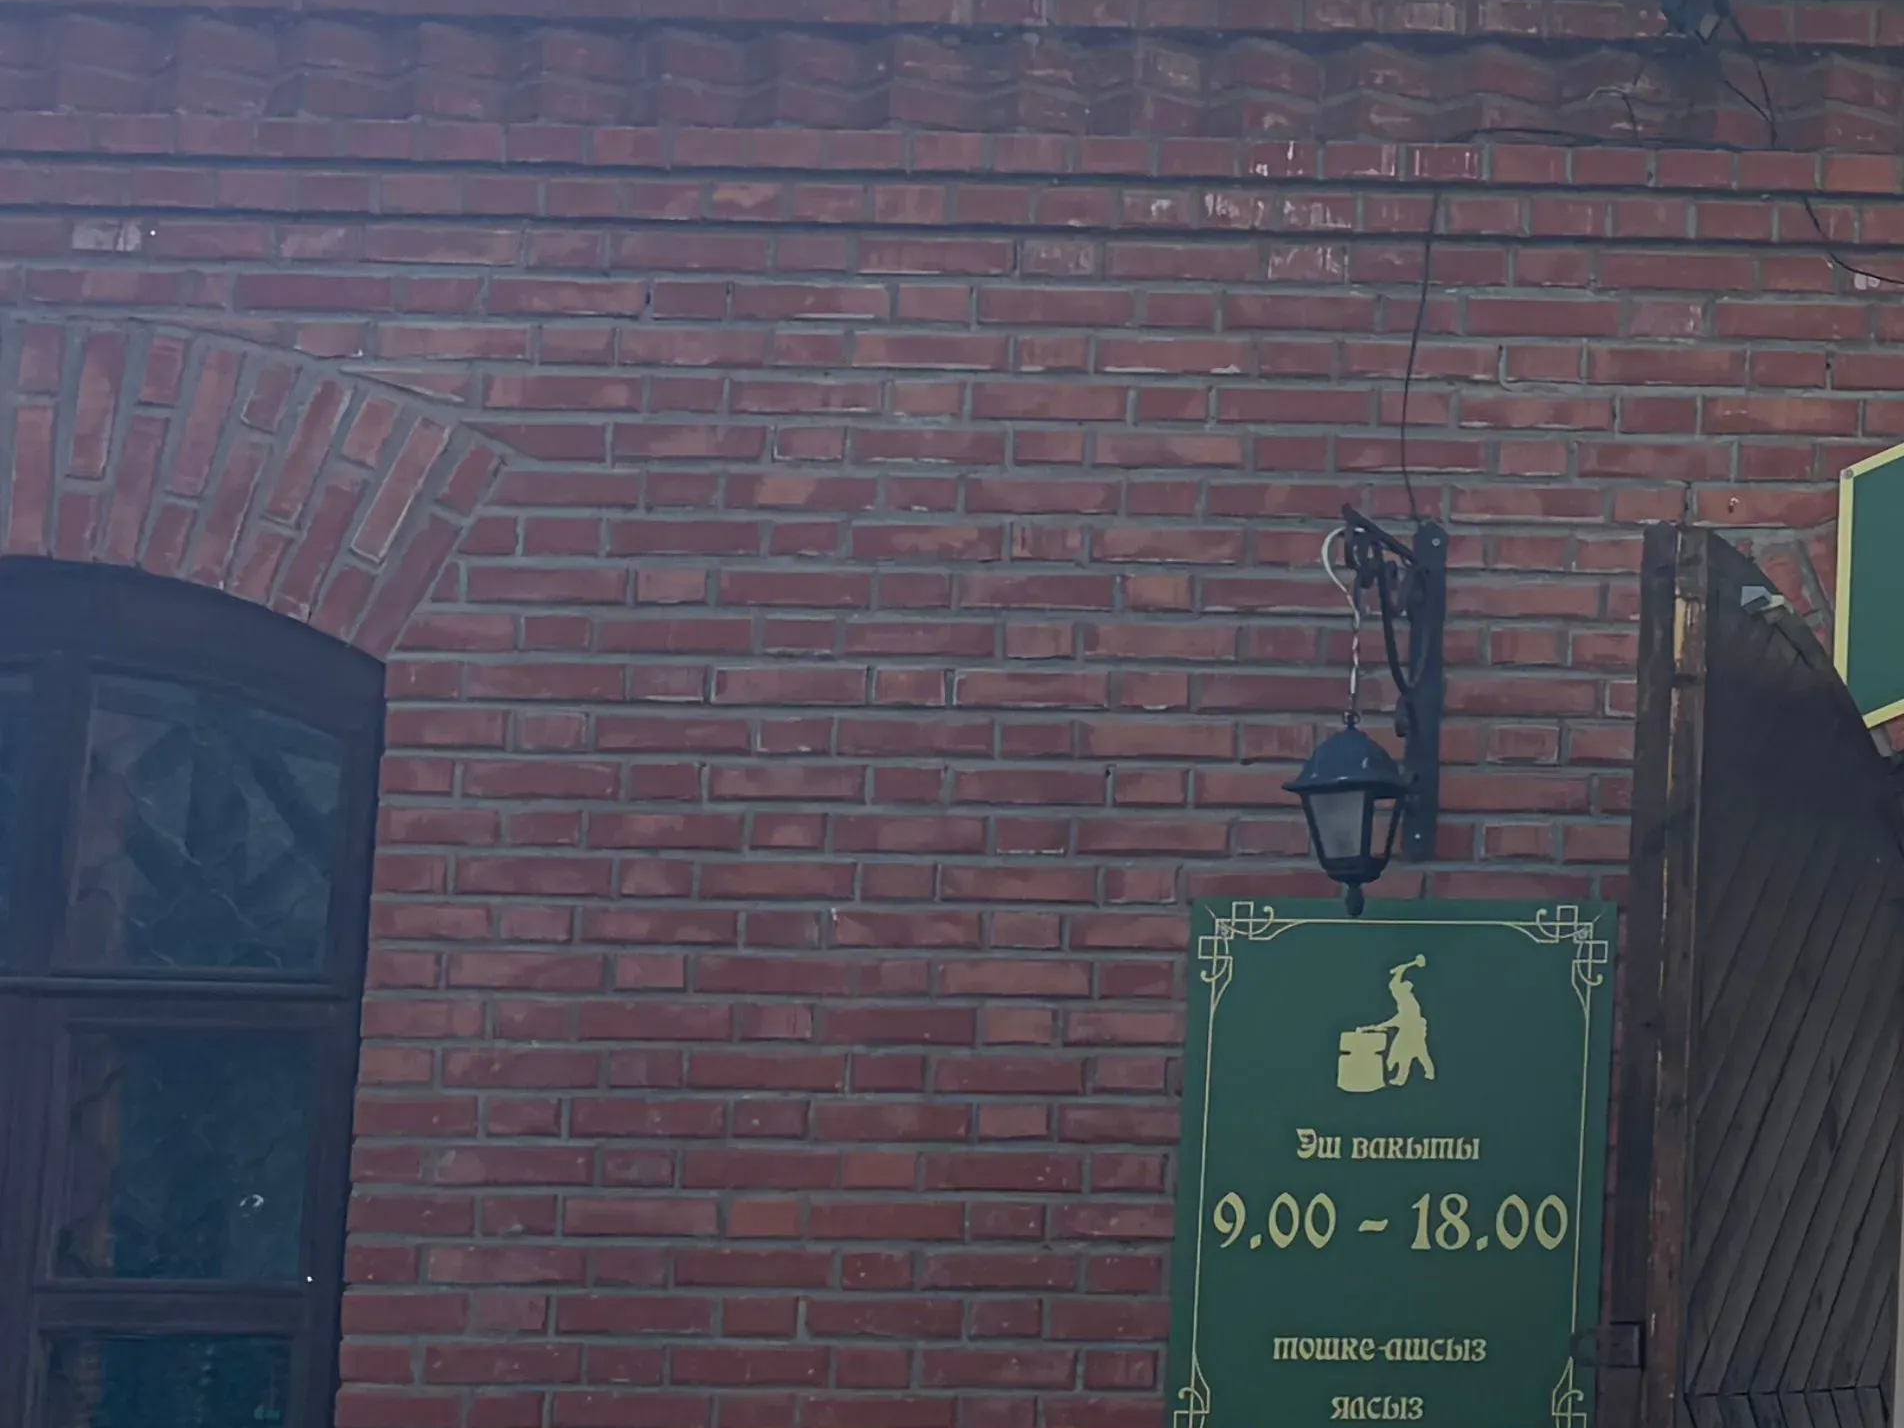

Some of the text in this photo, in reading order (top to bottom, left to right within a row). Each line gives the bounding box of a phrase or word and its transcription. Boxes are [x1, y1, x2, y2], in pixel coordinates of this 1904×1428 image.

[1295, 1127, 1481, 1161] Эш вакыты
[1212, 1191, 1338, 1250] 9.00
[1410, 1192, 1569, 1251] 18.00
[1329, 1395, 1424, 1421] ялсыз
